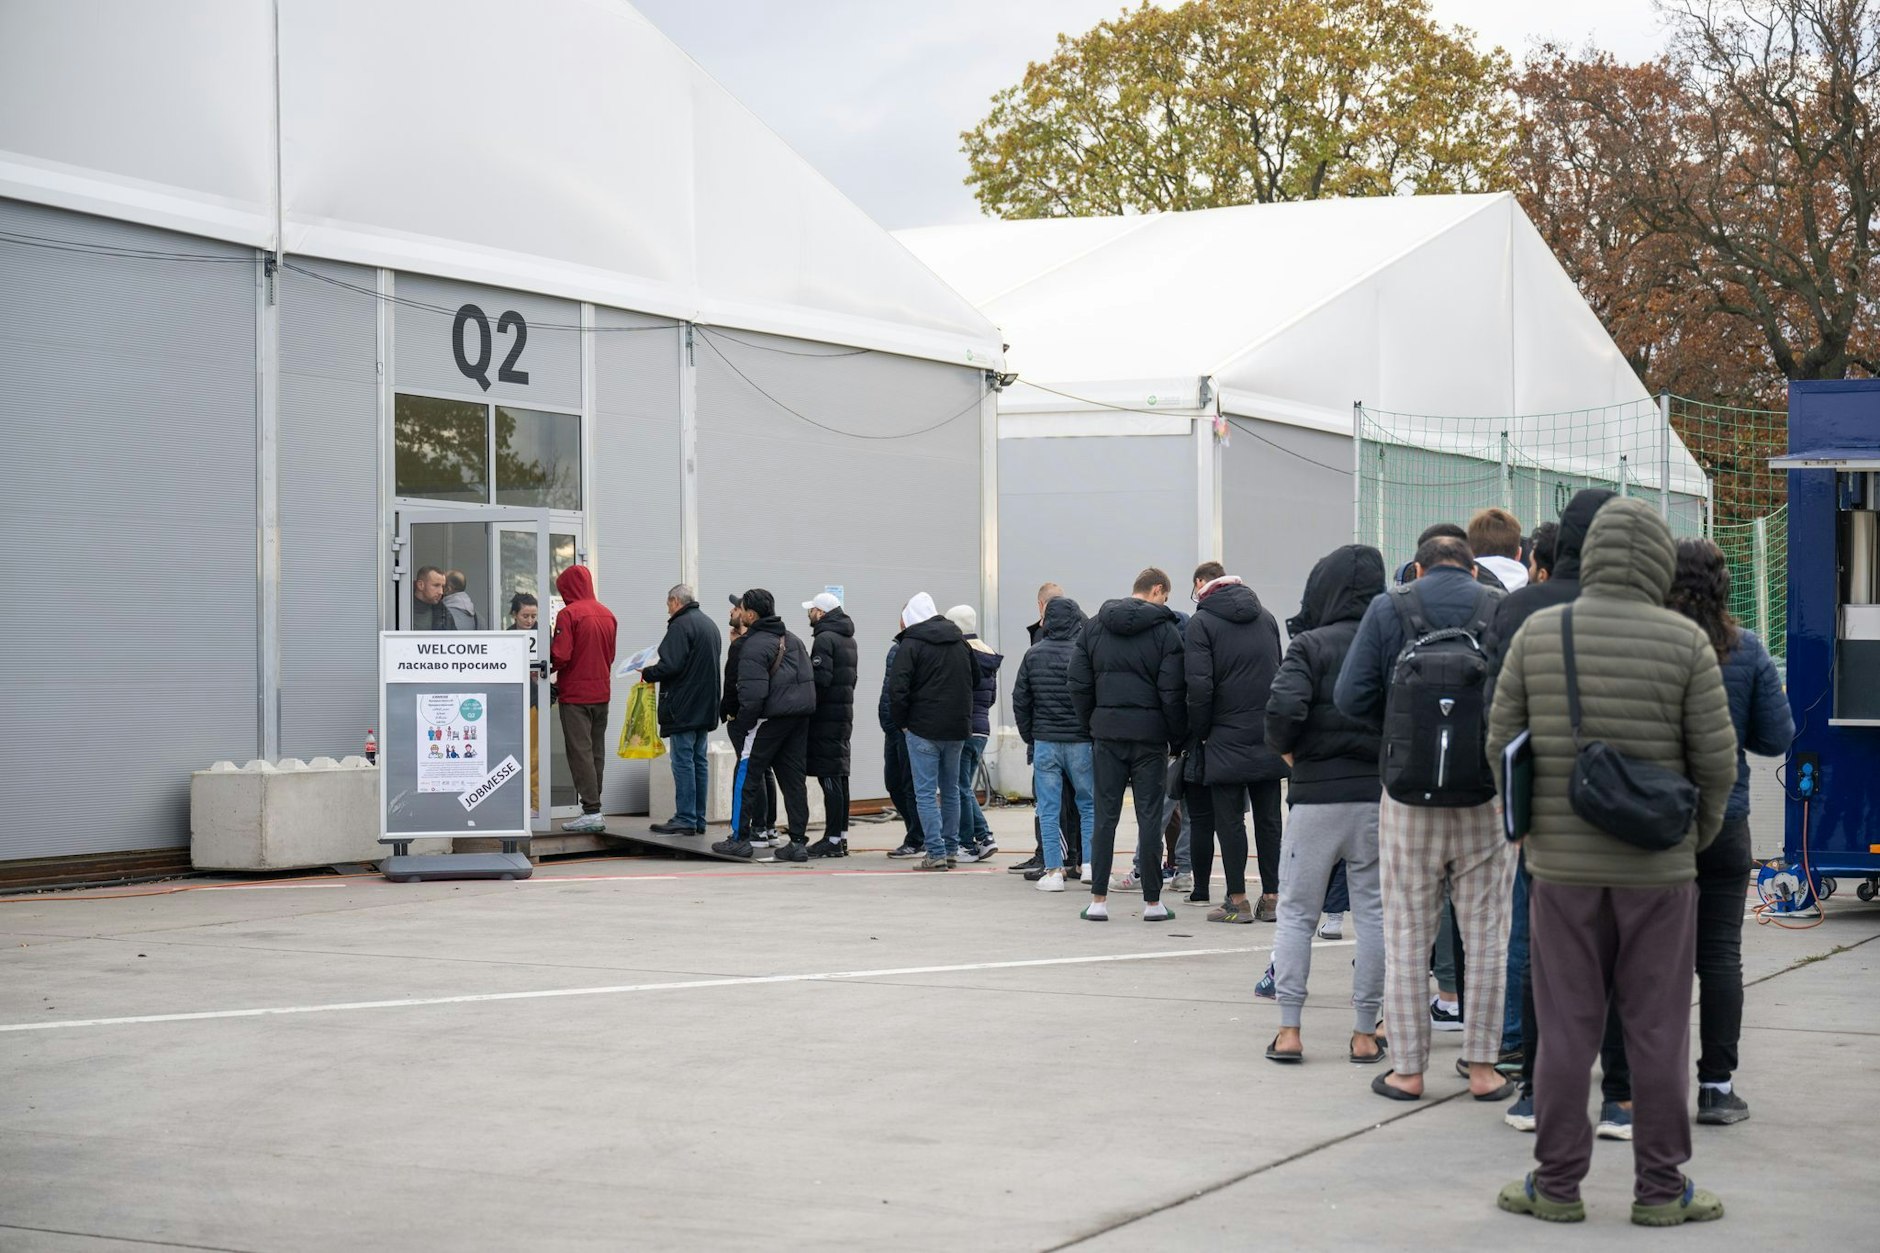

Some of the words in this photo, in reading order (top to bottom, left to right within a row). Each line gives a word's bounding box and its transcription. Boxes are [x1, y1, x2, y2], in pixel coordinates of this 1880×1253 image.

[452, 303, 530, 392] Q2
[417, 643, 488, 655] WELCOME
[397, 661, 449, 670] ласкаво
[451, 661, 507, 673] просимо
[465, 762, 516, 808] JOBMESSE
